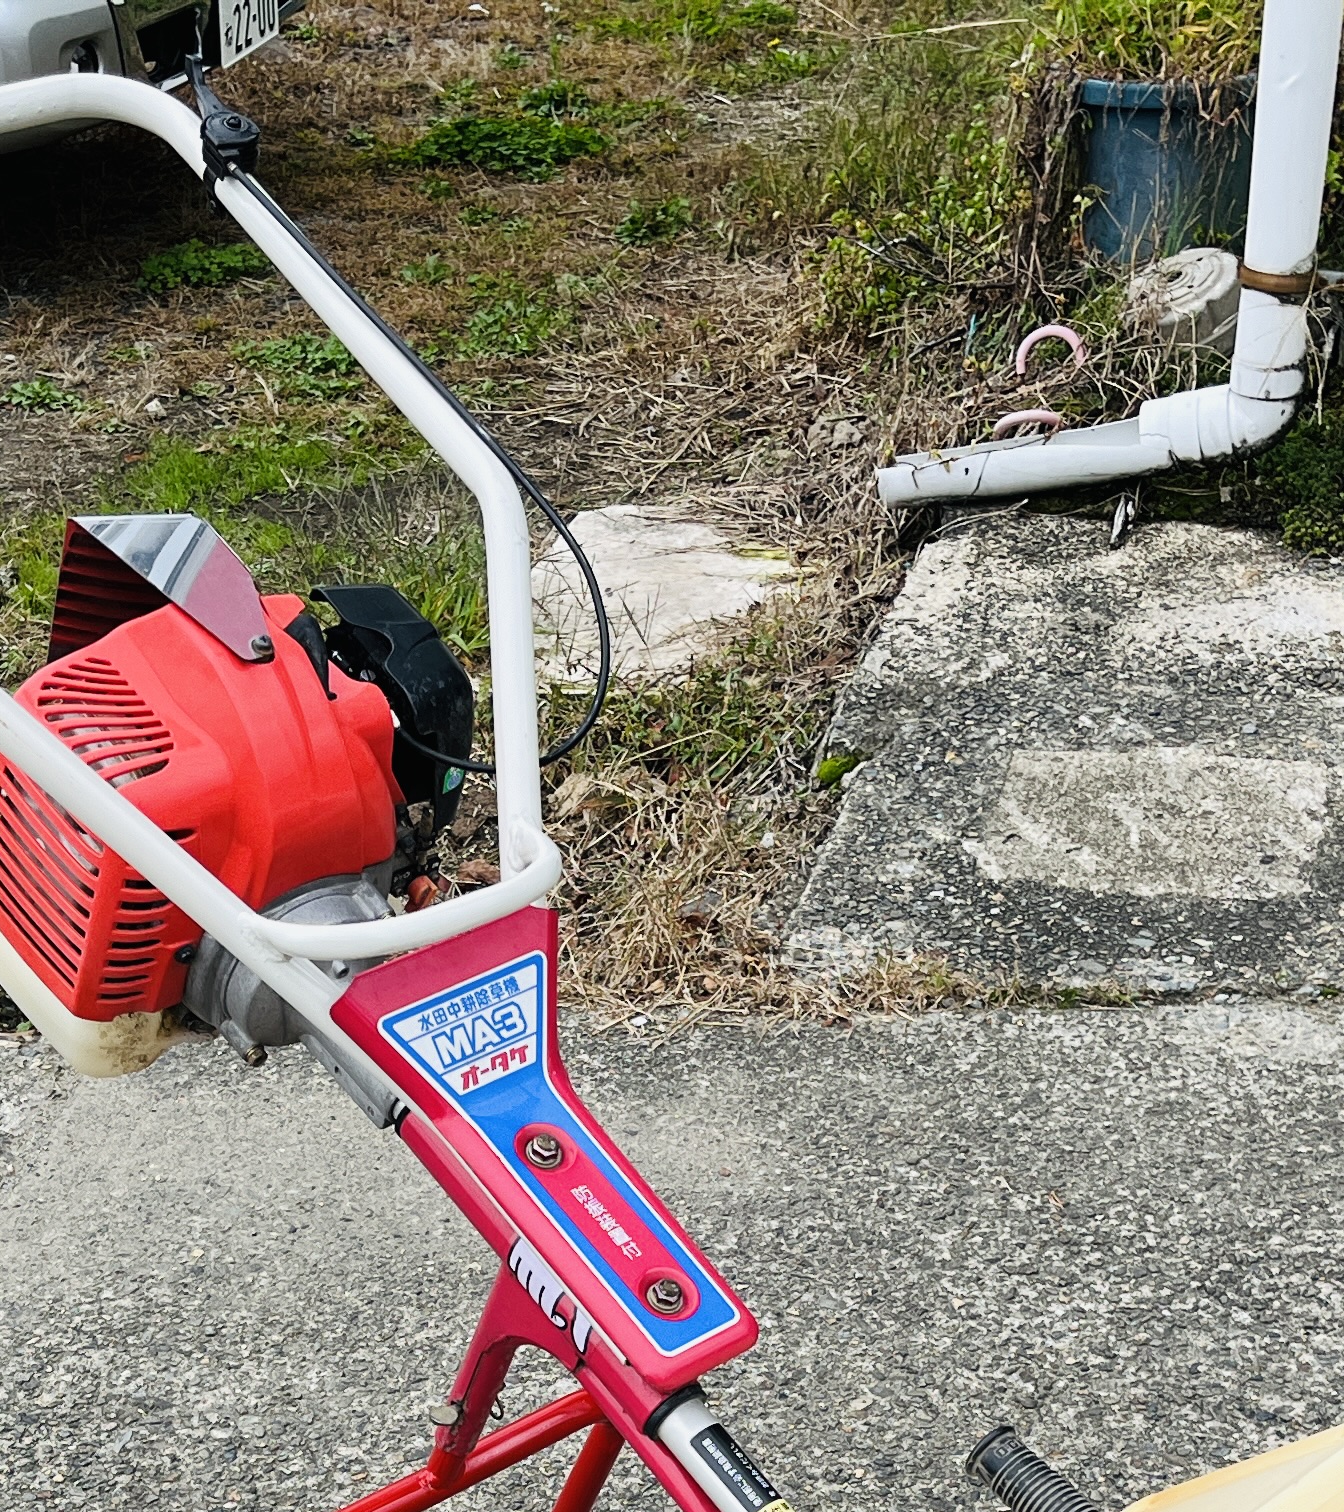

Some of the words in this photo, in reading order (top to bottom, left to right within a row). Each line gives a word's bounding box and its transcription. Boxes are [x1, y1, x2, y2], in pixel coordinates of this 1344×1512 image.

[233, 0, 275, 54] 22-00
[418, 976, 520, 1032] 水田中耕除草機
[432, 1001, 528, 1069] MA3
[461, 1044, 528, 1091] オータケ
[570, 1185, 642, 1261] 防振装置付
